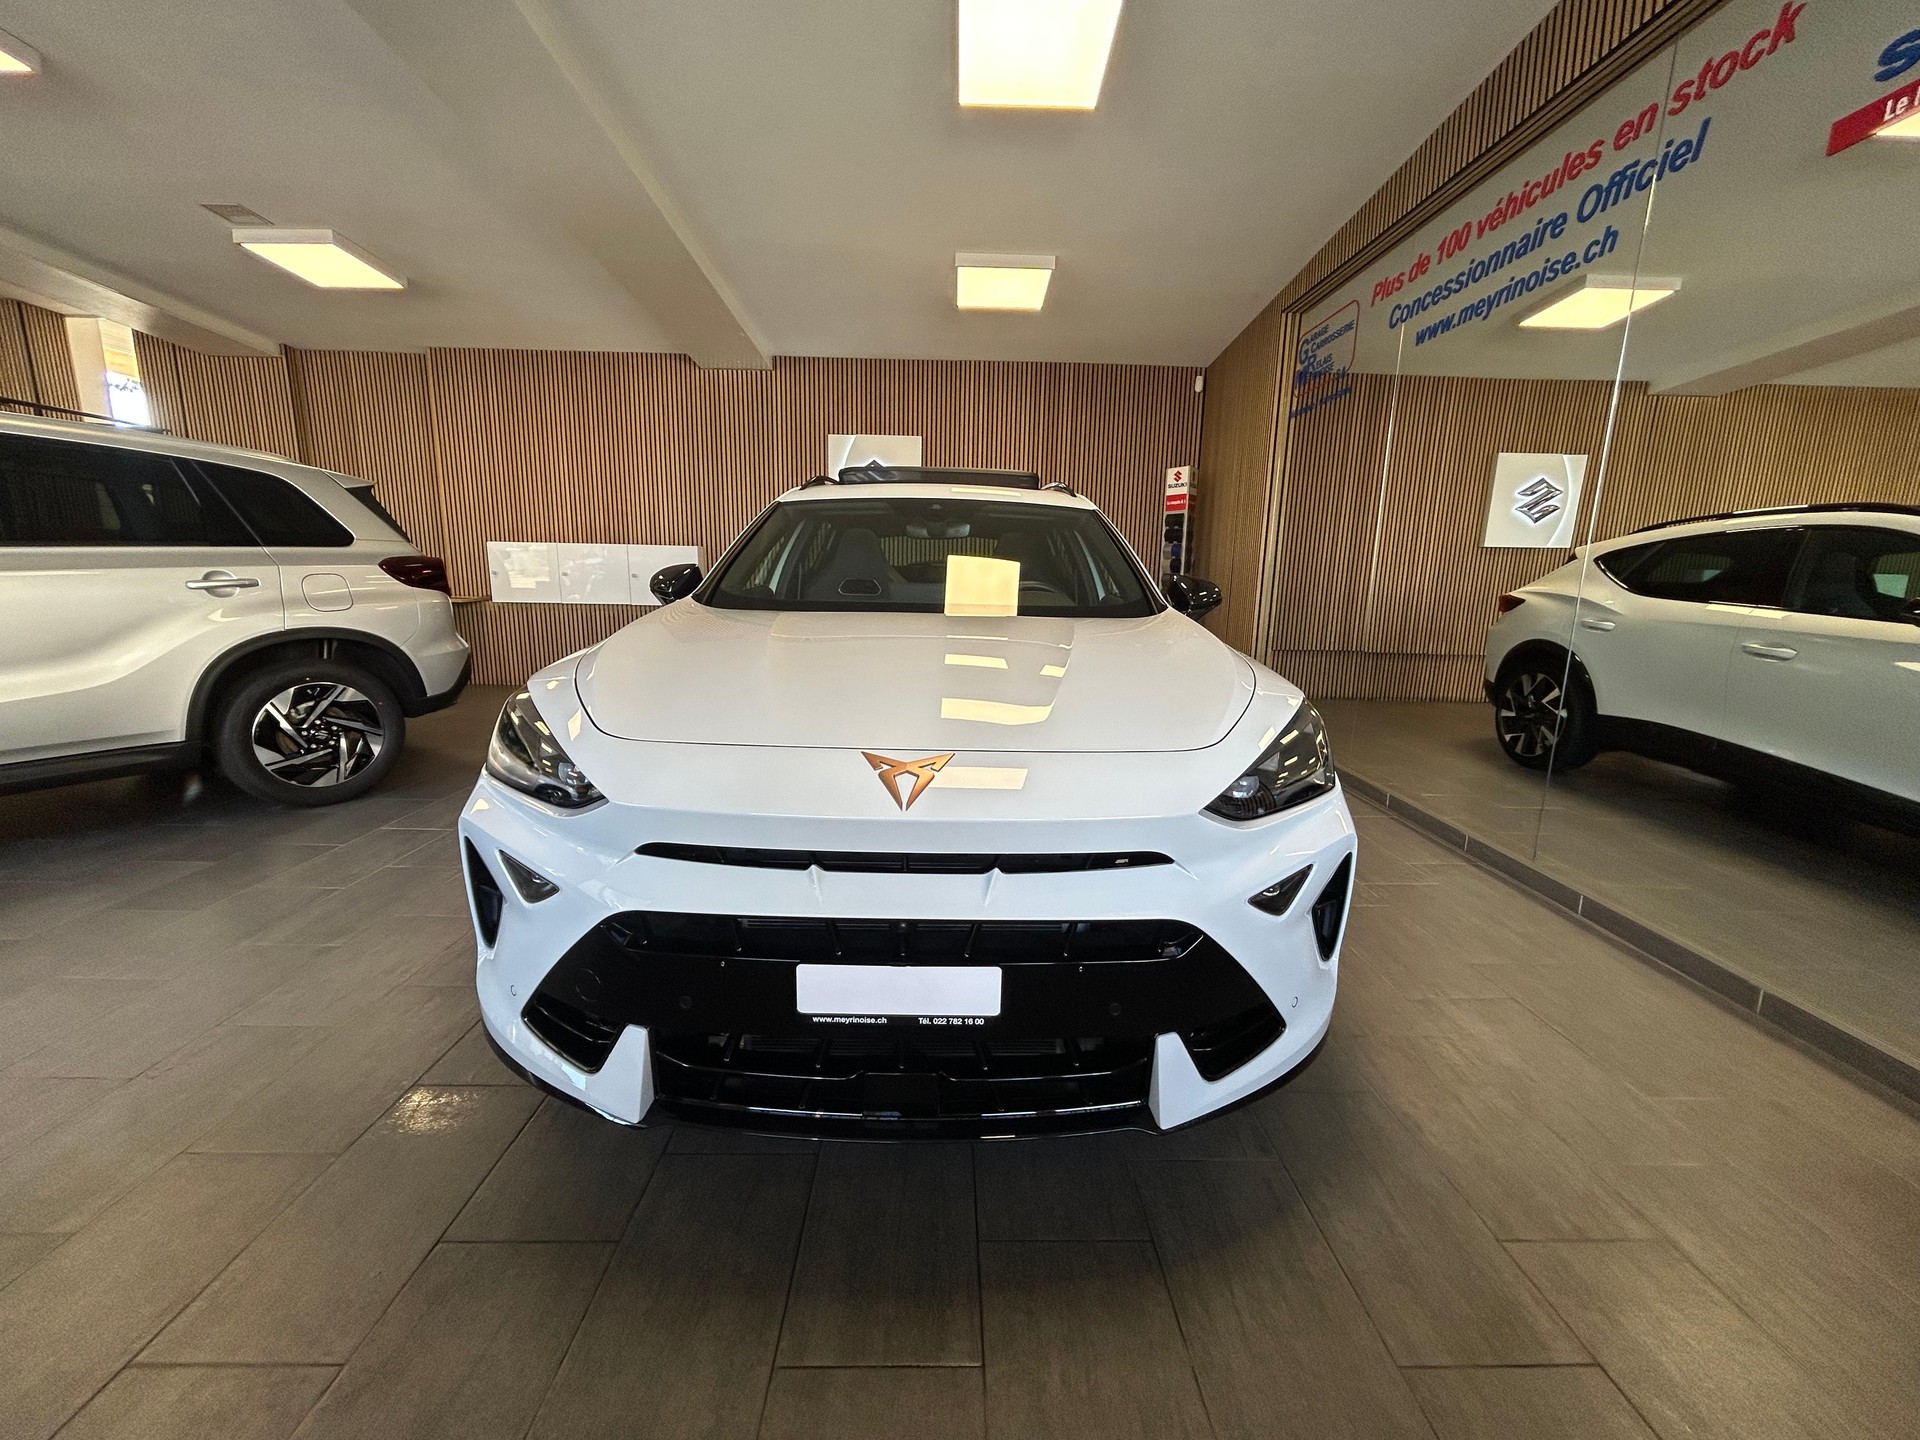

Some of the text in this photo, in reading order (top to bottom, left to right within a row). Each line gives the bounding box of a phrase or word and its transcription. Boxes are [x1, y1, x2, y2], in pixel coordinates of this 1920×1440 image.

[1370, 1, 1808, 308] Plus de 100 véhicules en stock
[1883, 96, 1910, 122] Le
[1389, 116, 1712, 329] Concessionnaire Officiel
[1415, 225, 1619, 346] www.meyrinoise.ch
[932, 1017, 947, 1025] 022
[948, 1017, 963, 1026] 782
[974, 1018, 985, 1026] 00
